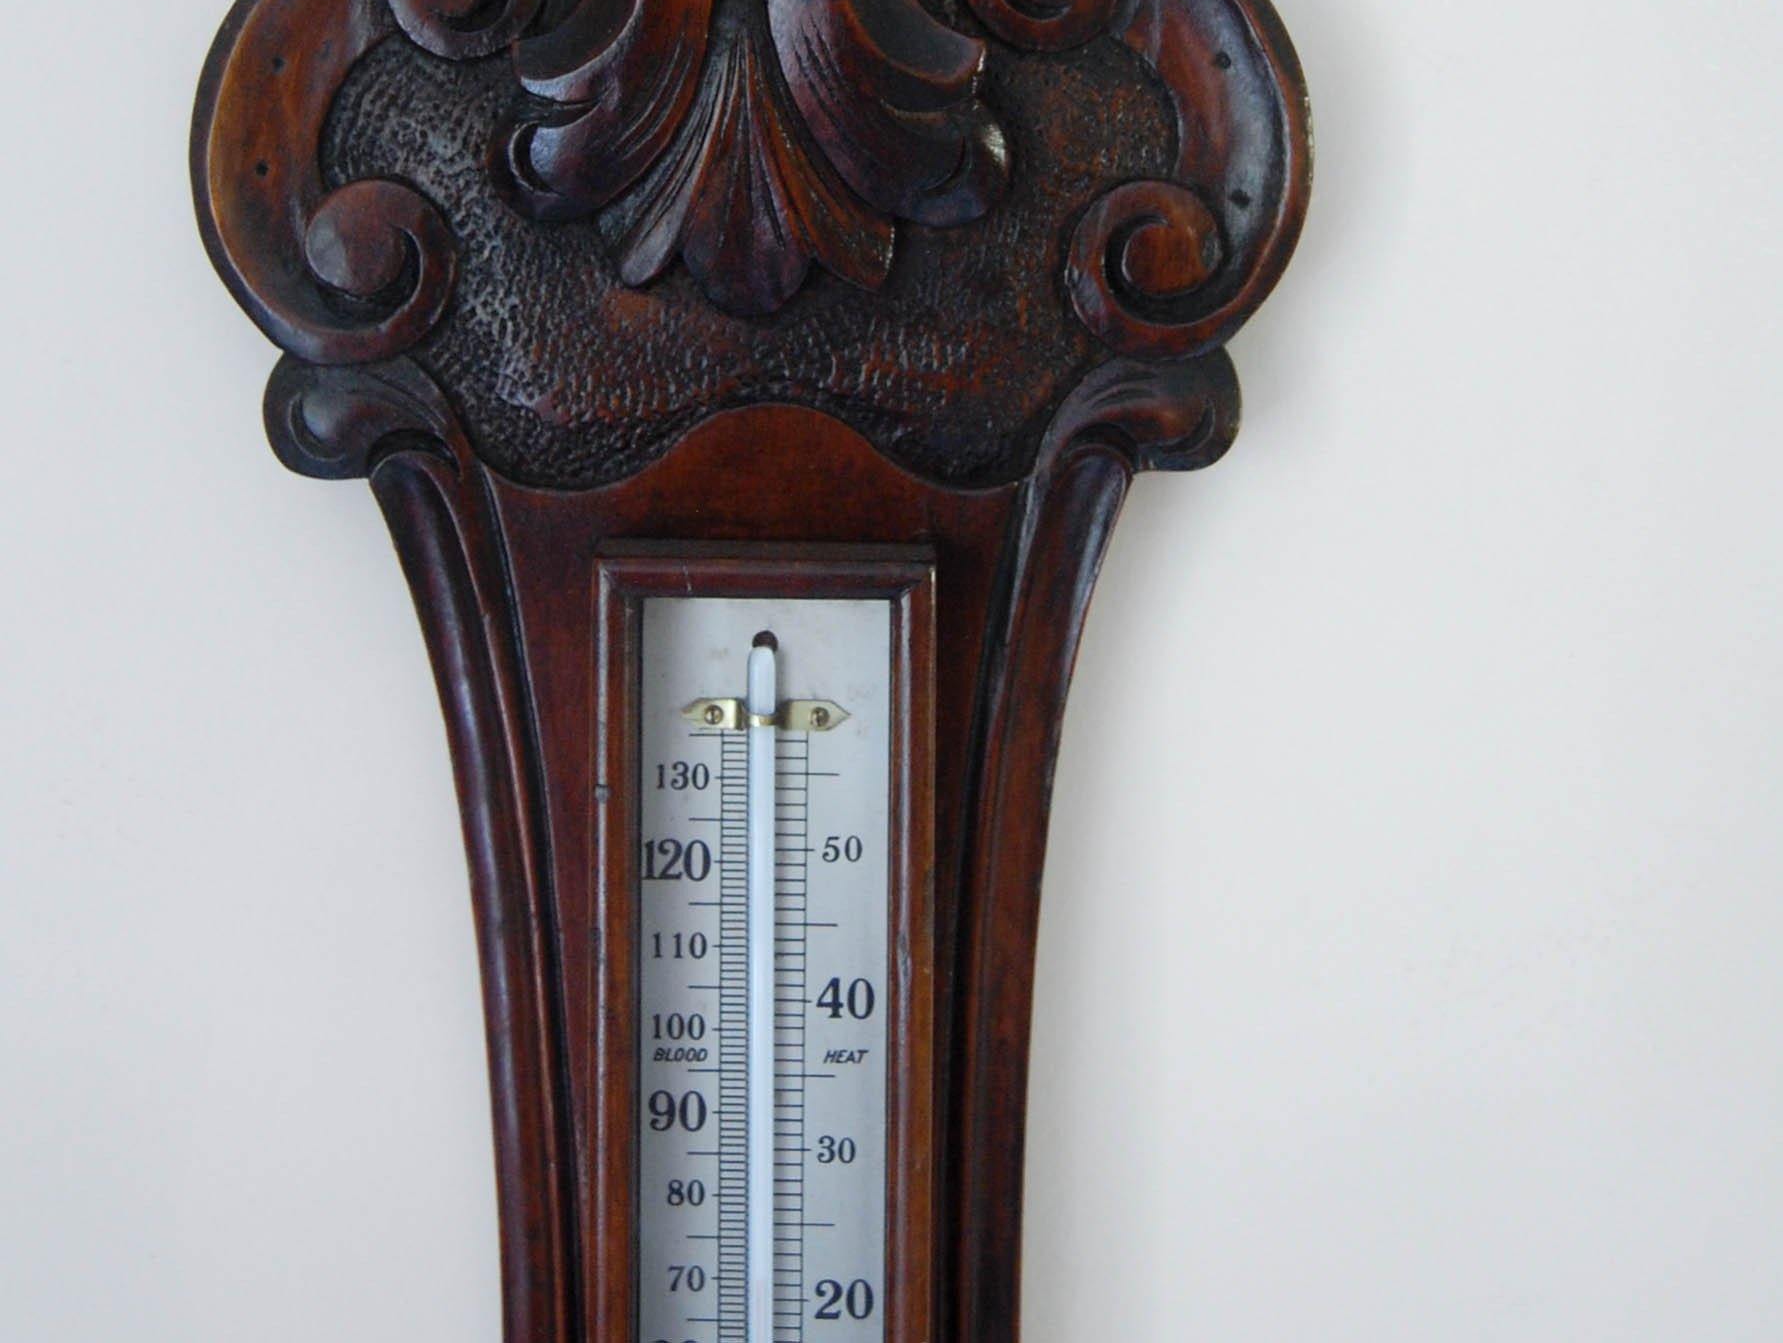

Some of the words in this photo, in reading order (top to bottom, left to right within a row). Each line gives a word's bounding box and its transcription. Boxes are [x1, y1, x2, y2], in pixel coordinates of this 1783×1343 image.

[655, 761, 710, 791] 130
[642, 838, 711, 882] 120
[821, 835, 863, 863] 50
[653, 932, 708, 960] 110
[815, 977, 875, 1020] 40
[652, 1013, 706, 1041] 100
[653, 1047, 708, 1062] BLOOD
[823, 1049, 869, 1064] HEAT
[648, 1090, 707, 1133] 90
[817, 1135, 856, 1164] 30
[666, 1179, 706, 1207] 80
[667, 1265, 706, 1293] 70
[814, 1278, 875, 1321] 20
